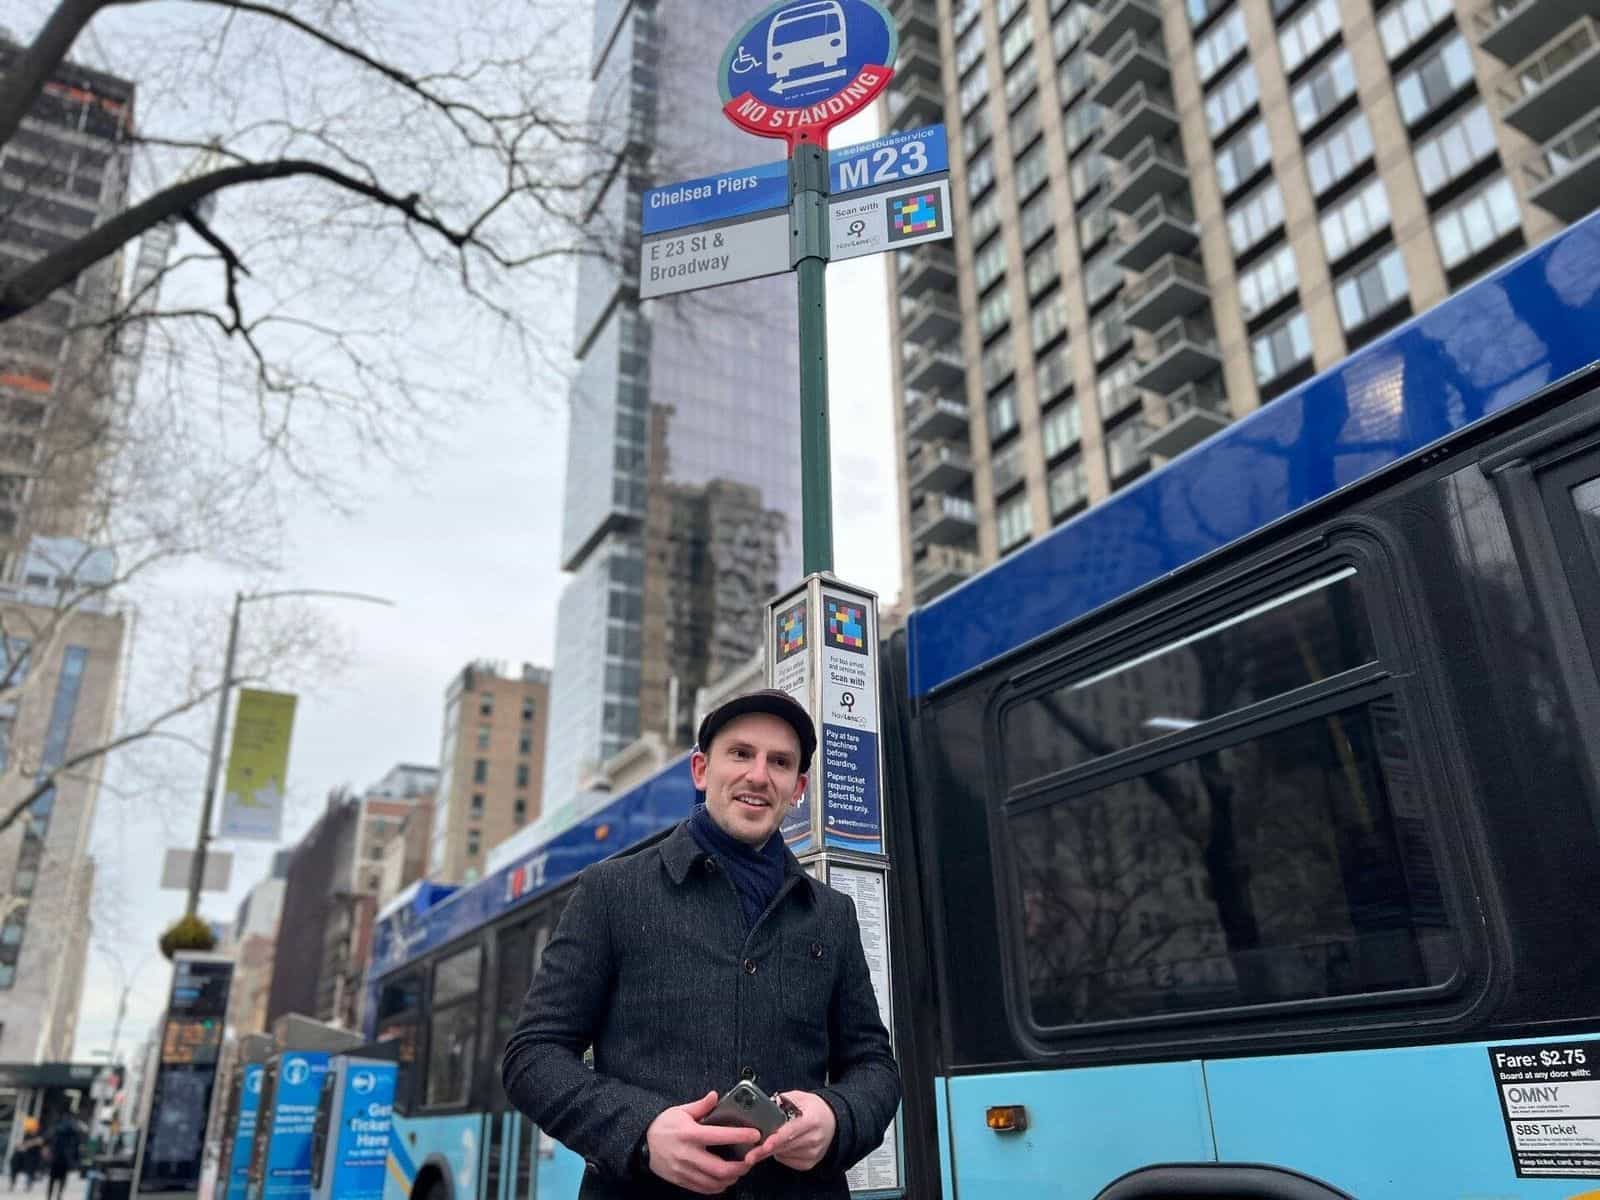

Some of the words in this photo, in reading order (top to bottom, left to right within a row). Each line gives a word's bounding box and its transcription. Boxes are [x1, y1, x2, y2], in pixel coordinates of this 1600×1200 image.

[737, 98, 766, 123] NO
[769, 72, 880, 128] STANDING
[840, 141, 928, 190] M23
[651, 184, 712, 208] Chelsea
[717, 175, 758, 195] Piers
[835, 207, 857, 217] Scan
[859, 202, 879, 212] with
[651, 245, 660, 261] E
[665, 240, 685, 258] 23
[691, 235, 707, 252] St
[712, 232, 725, 247] &
[651, 255, 729, 281] Broadway
[830, 671, 848, 683] Scan
[850, 676, 865, 687] with
[826, 729, 838, 740] Pay
[839, 731, 847, 740] at
[847, 732, 860, 742] fare
[826, 739, 858, 751] machines
[826, 748, 848, 758] before
[826, 758, 857, 771] boarding.
[827, 771, 847, 782] Paper
[847, 775, 865, 785] ticket
[827, 782, 855, 793] required
[855, 785, 865, 794] for
[828, 790, 849, 801] Select
[850, 792, 863, 803] Bus
[828, 800, 853, 811] Service
[1496, 1053, 1537, 1068] Fare:
[1540, 1049, 1586, 1067] $2.75
[1500, 1072, 1523, 1080] Board
[1534, 1071, 1548, 1080] any
[1550, 1070, 1568, 1078] door
[1570, 1068, 1591, 1077] with:
[1508, 1086, 1559, 1103] OMNY
[1516, 1124, 1540, 1135] SBS
[1541, 1124, 1578, 1135] Ticket
